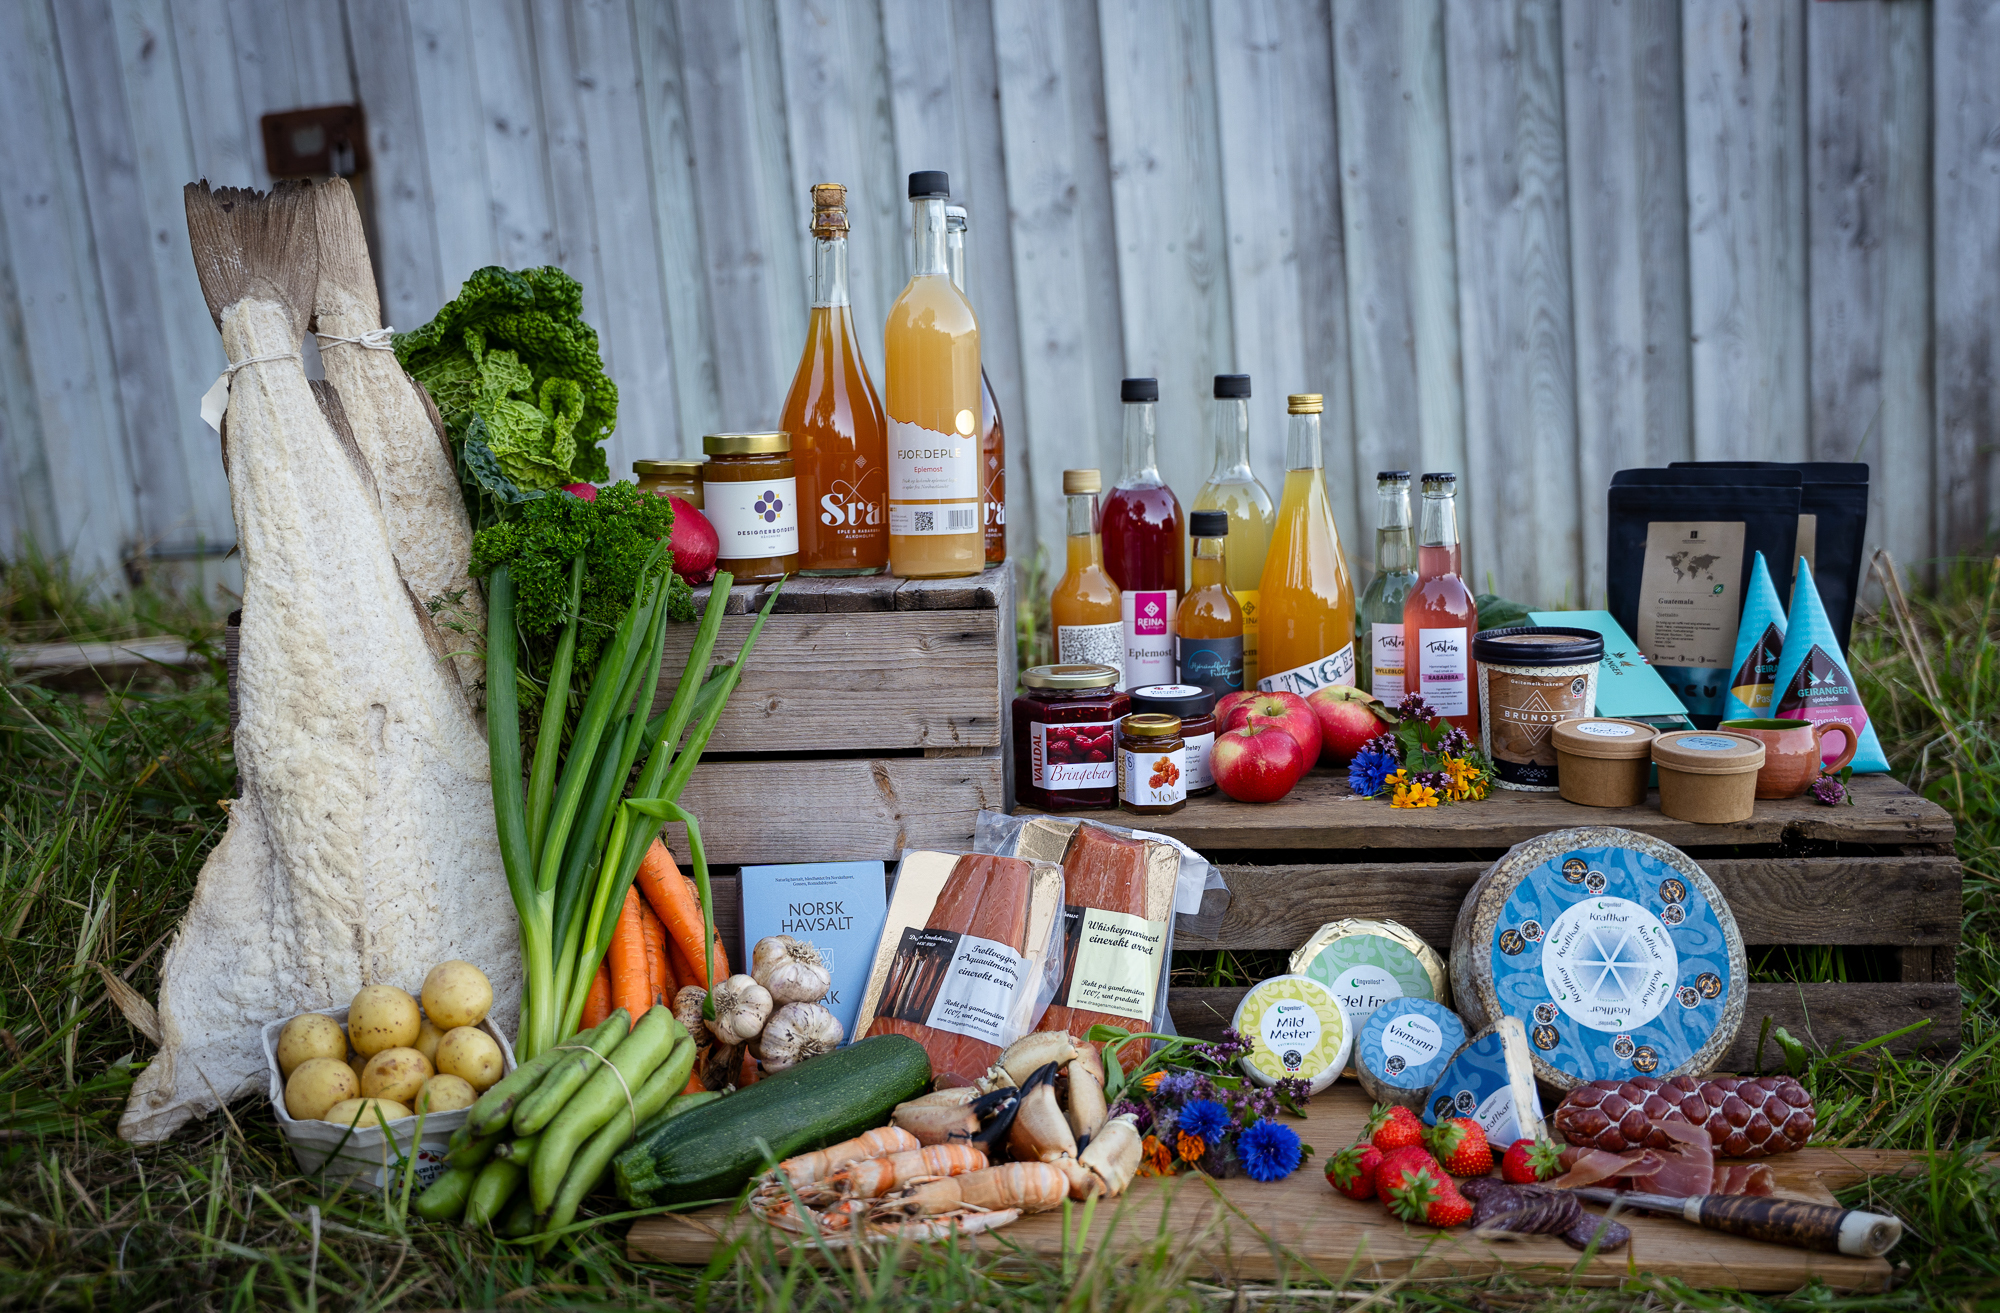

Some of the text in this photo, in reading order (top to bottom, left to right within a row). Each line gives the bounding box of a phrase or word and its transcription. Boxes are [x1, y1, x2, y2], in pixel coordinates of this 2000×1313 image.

[897, 448, 961, 460] FJORDEPLE
[914, 466, 943, 474] Eplemost
[1658, 597, 1694, 605] Guatemala
[1137, 617, 1165, 630] REINA
[1128, 648, 1172, 660] Eplemost
[1754, 664, 1779, 674] GEIRA
[1797, 686, 1849, 698] GEIRANGER
[1812, 696, 1838, 705] sjokolade
[1504, 710, 1566, 722] BRUNOST
[1033, 734, 1043, 781] VALLDAL
[1050, 762, 1113, 789] Bringebær
[1118, 755, 1126, 792] VALLDAL
[789, 901, 845, 917] NORSK
[1589, 912, 1630, 922] Kraftkar
[781, 916, 853, 933] HAVSALT
[1087, 920, 1160, 942] Whiskeymarinert
[1107, 984, 1145, 996] gamlemåten
[1083, 989, 1101, 999] 100%
[1114, 994, 1140, 1004] produkt
[960, 1001, 968, 1009] på
[944, 1008, 961, 1018] 100%
[973, 1015, 999, 1028] produkt
[1276, 1017, 1305, 1028] Mild
[1270, 1029, 1312, 1040] Mester
[1390, 1025, 1434, 1052] Vismann
